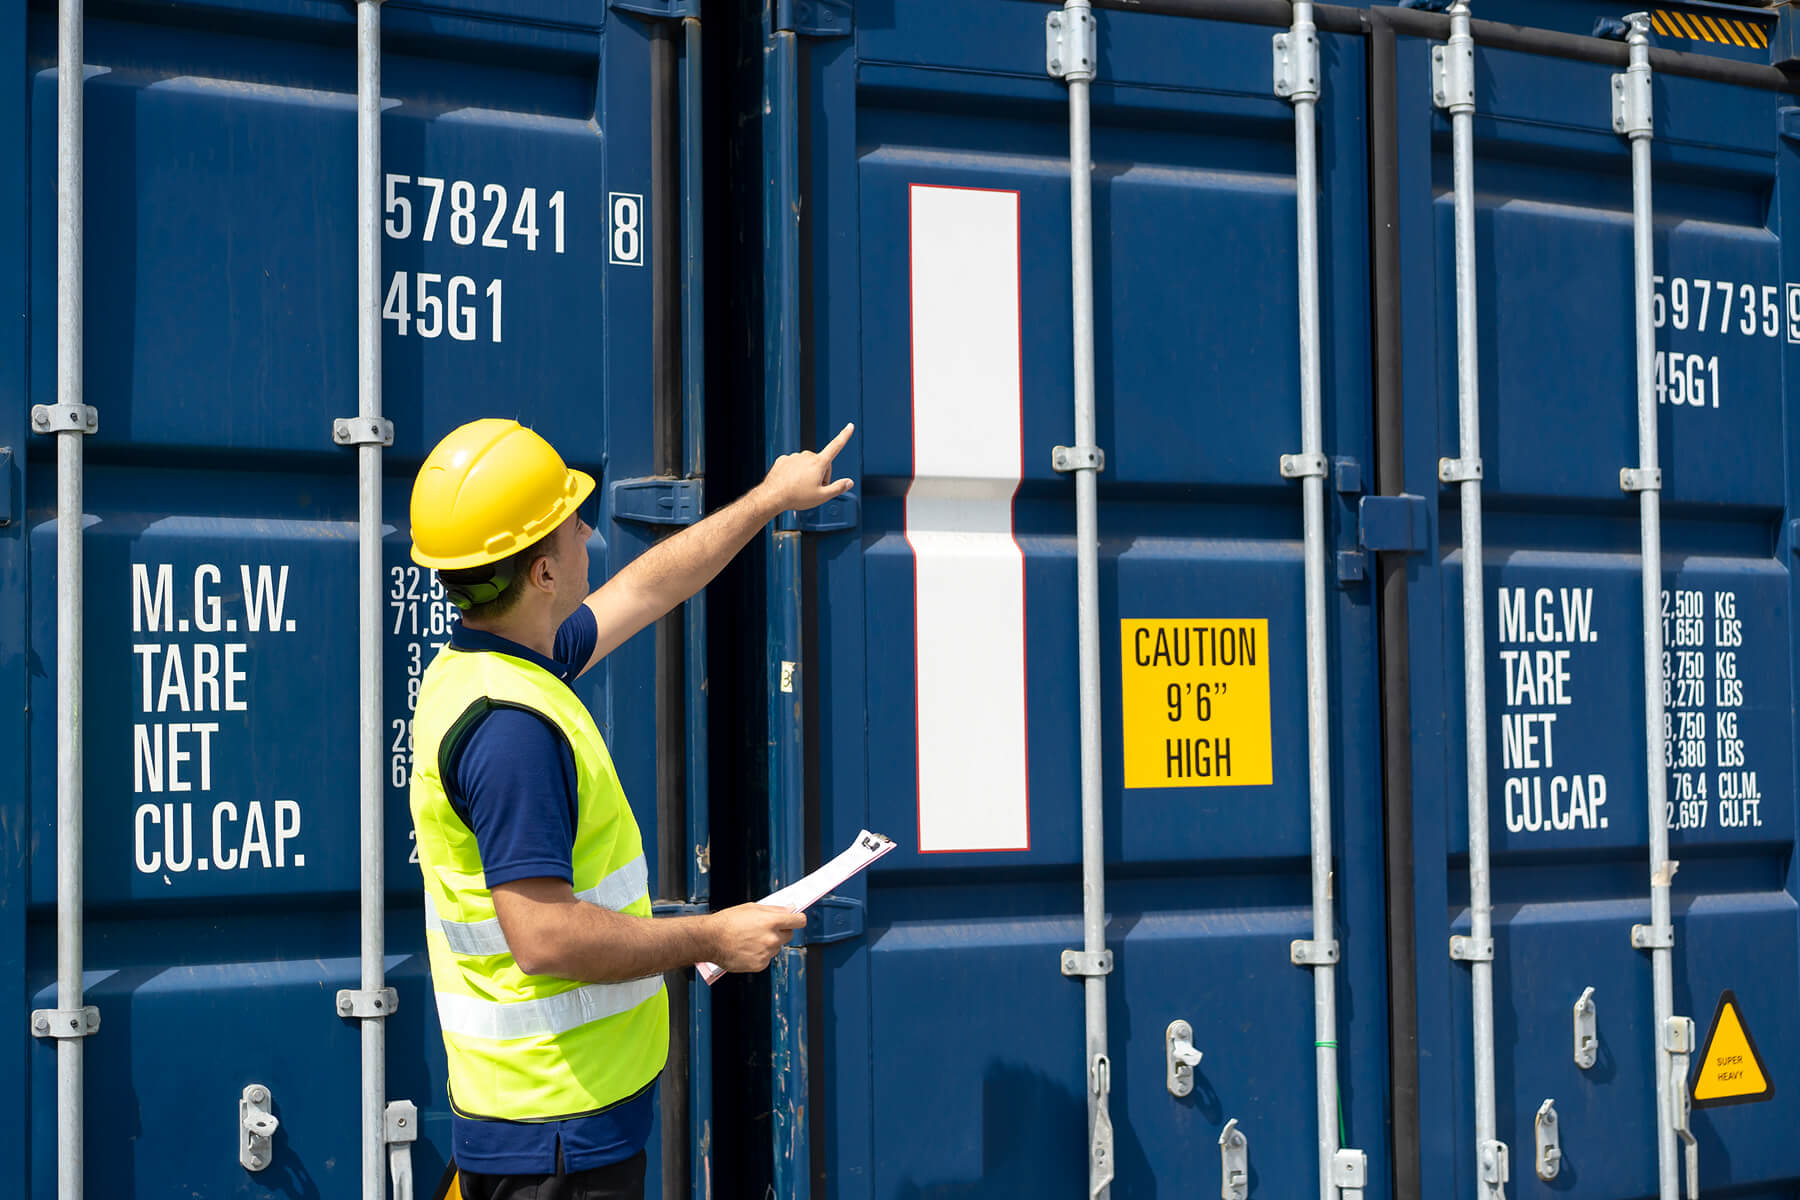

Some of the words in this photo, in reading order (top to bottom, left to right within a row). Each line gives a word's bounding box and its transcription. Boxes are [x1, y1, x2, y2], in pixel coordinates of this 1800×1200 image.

[385, 173, 565, 254] 578241
[614, 198, 639, 262] 8
[382, 271, 502, 343] 45G1
[1653, 275, 1780, 337] 597735
[1655, 351, 1720, 409] 45G1
[131, 563, 297, 633] M.G.W.
[391, 566, 449, 602] 32,5
[391, 601, 461, 637] 71,65
[1498, 587, 1598, 643] M.G.W.
[1661, 590, 1704, 619] 2,500
[1715, 591, 1735, 619] KG
[1135, 627, 1256, 667] CAUTION
[1663, 618, 1704, 648] 1,650
[1715, 619, 1742, 647] LBS
[133, 643, 248, 713] TARE
[1500, 650, 1572, 706] TARE
[1662, 651, 1704, 680] 3,750
[1716, 652, 1736, 679] KG
[1663, 679, 1705, 708] 8,270
[1716, 680, 1743, 707] LBS
[1502, 713, 1557, 769] NET
[1664, 712, 1706, 741] 8,750
[1717, 711, 1737, 739] KG
[134, 723, 219, 793] NET
[1166, 738, 1231, 778] HIGH
[1664, 740, 1706, 769] 3,380
[1718, 740, 1744, 767] LBS
[1504, 774, 1608, 832] CU.CAP.
[1672, 772, 1707, 800] 76.4
[1718, 771, 1761, 799] CU.M.
[1666, 800, 1708, 831] 2,697
[1719, 800, 1762, 827] CU.FT.
[135, 800, 305, 873] CU.CAP.
[1717, 1056, 1743, 1066] SUPER
[1717, 1071, 1744, 1081] HEAVY
